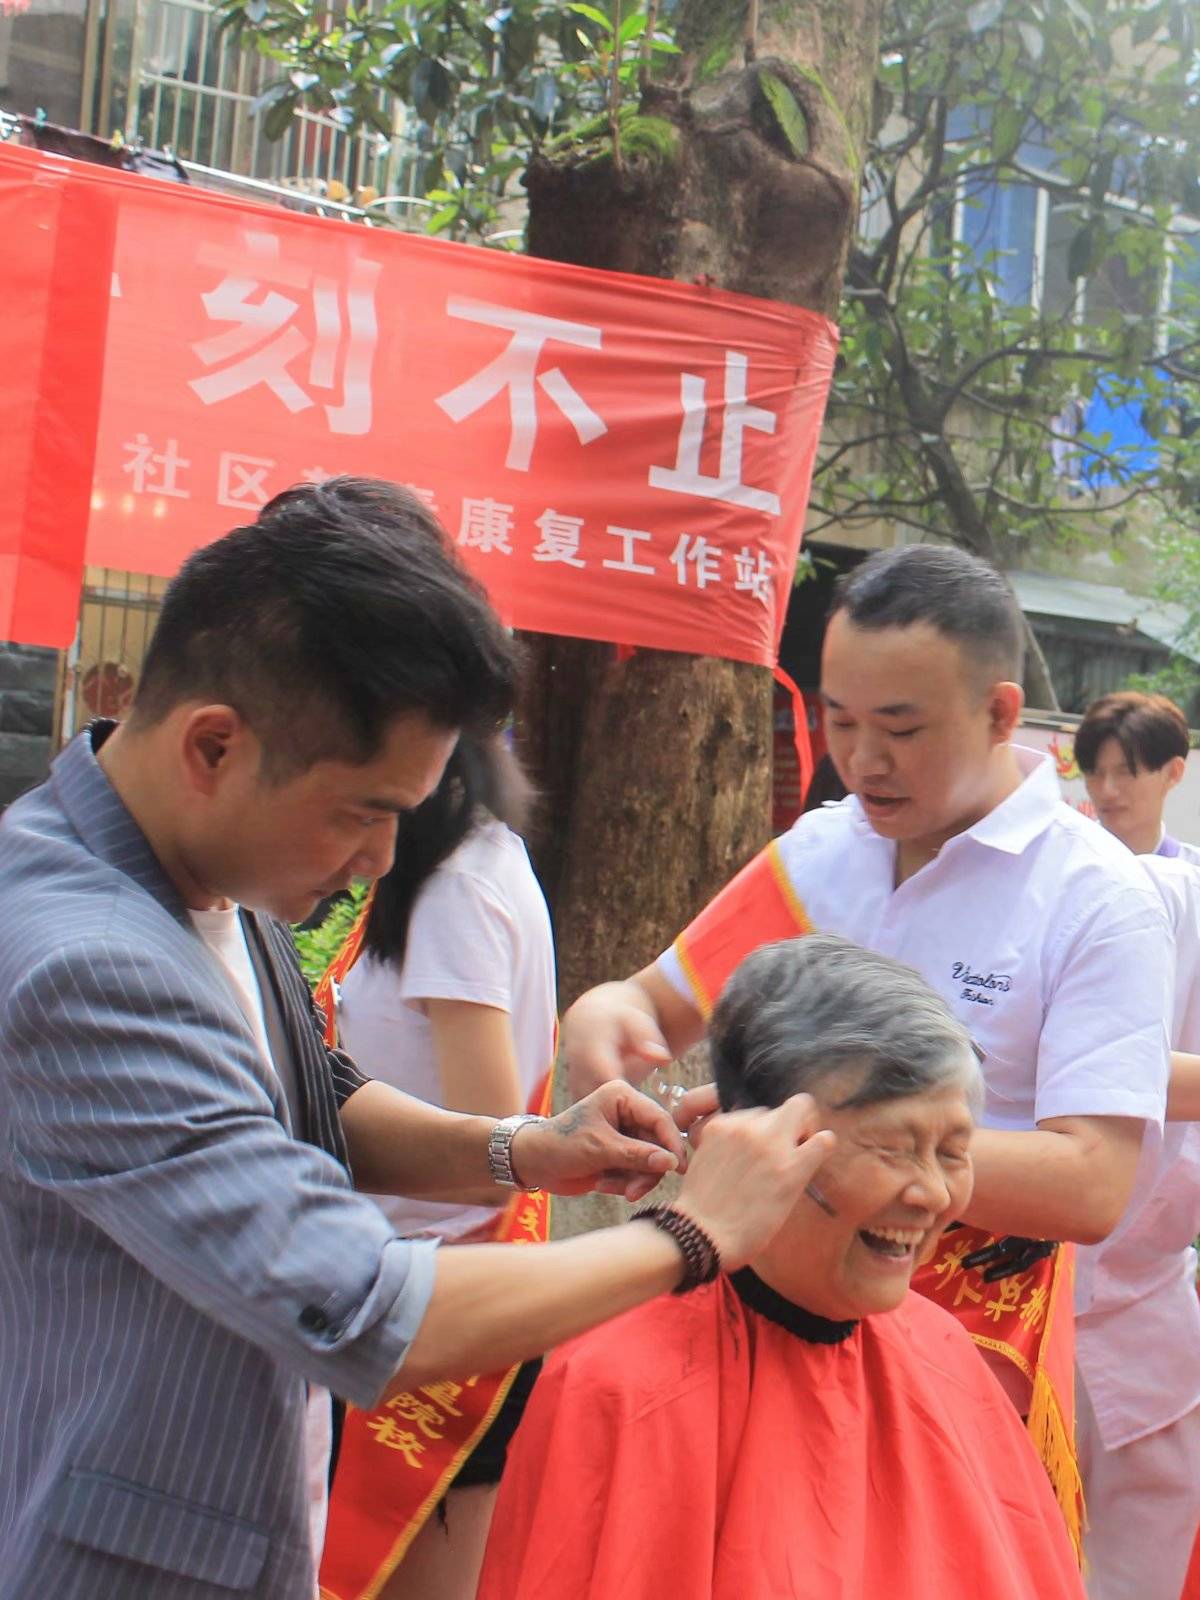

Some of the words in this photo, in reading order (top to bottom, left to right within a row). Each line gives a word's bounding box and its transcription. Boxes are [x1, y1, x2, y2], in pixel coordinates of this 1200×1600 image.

[112, 232, 782, 517] 刻不止
[122, 432, 775, 600] 社区康复工作站
